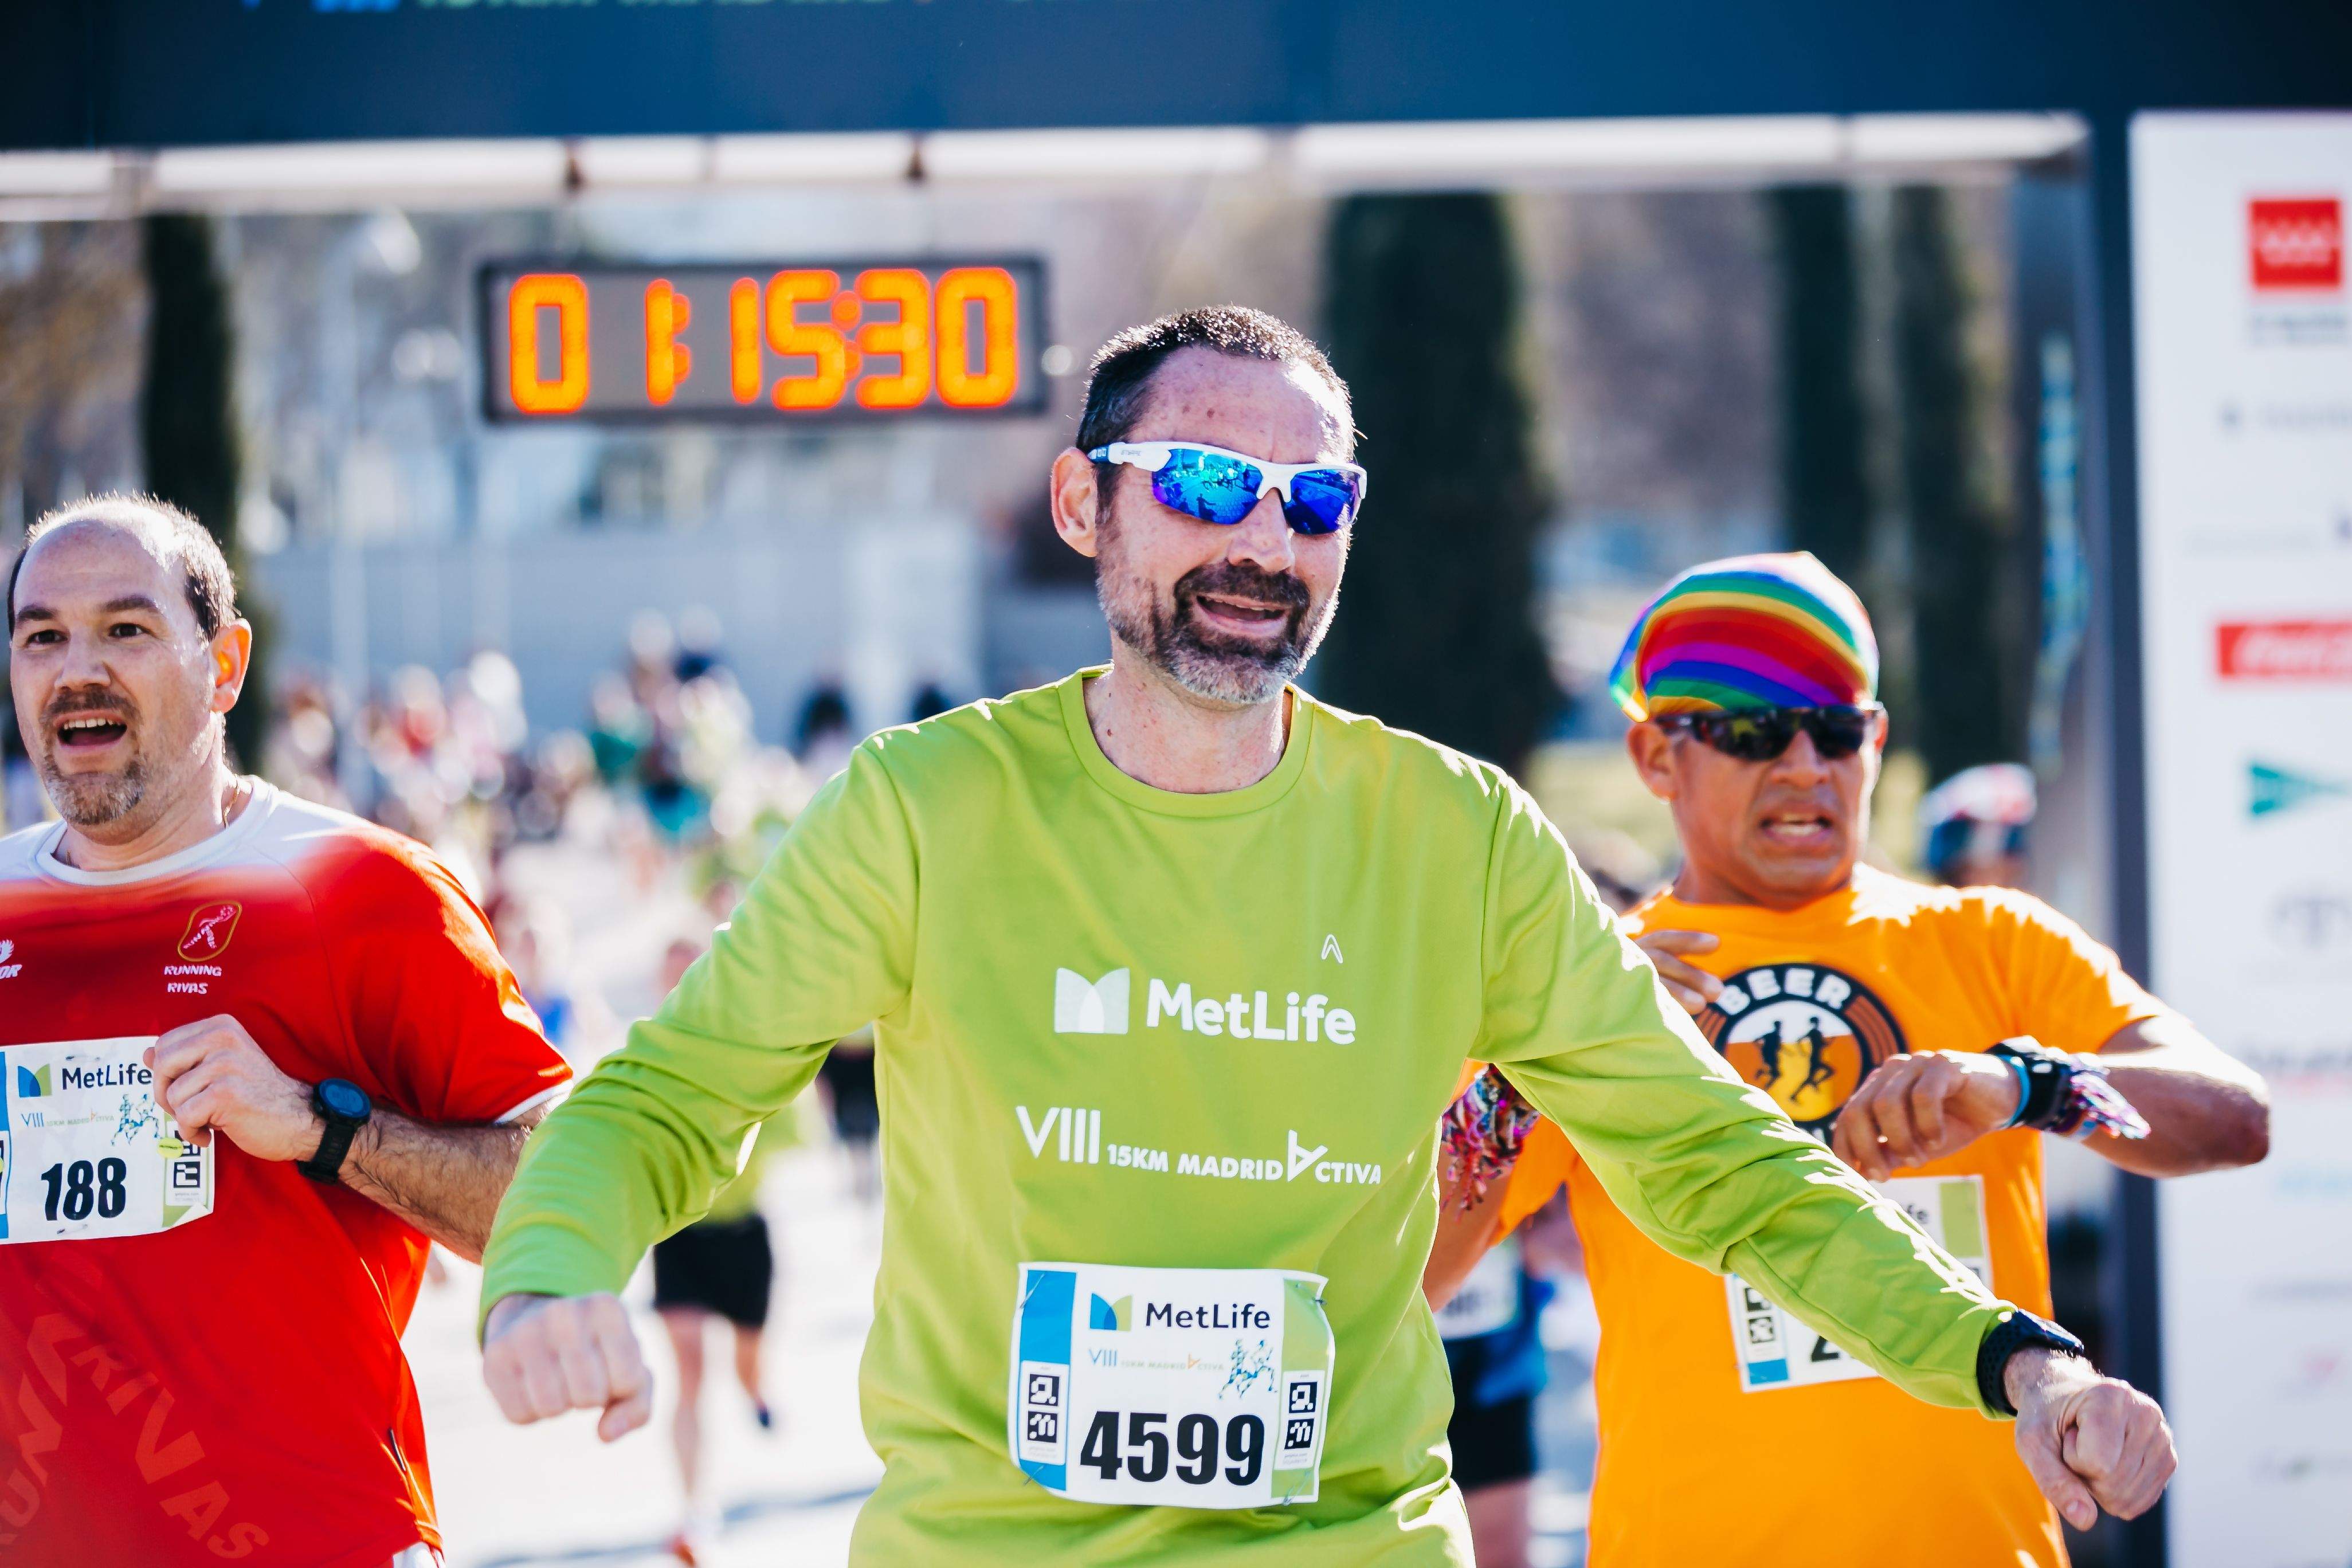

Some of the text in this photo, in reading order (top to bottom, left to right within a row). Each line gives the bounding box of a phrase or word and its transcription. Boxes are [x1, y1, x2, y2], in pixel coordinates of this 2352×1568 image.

[164, 965, 222, 977] RUNNING
[167, 982, 209, 995] RIVAS
[1716, 967, 1852, 1016] BEER
[1146, 978, 1357, 1045] MetLife
[61, 1063, 152, 1090] MetLife
[21, 1112, 44, 1127] VIII
[1016, 1106, 1101, 1164] VIII
[1107, 1144, 1169, 1173] 15KM
[41, 1157, 127, 1221] 188
[1145, 1302, 1271, 1329] MetLife
[1088, 1348, 1118, 1366] VIII
[1080, 1410, 1265, 1486] 4599
